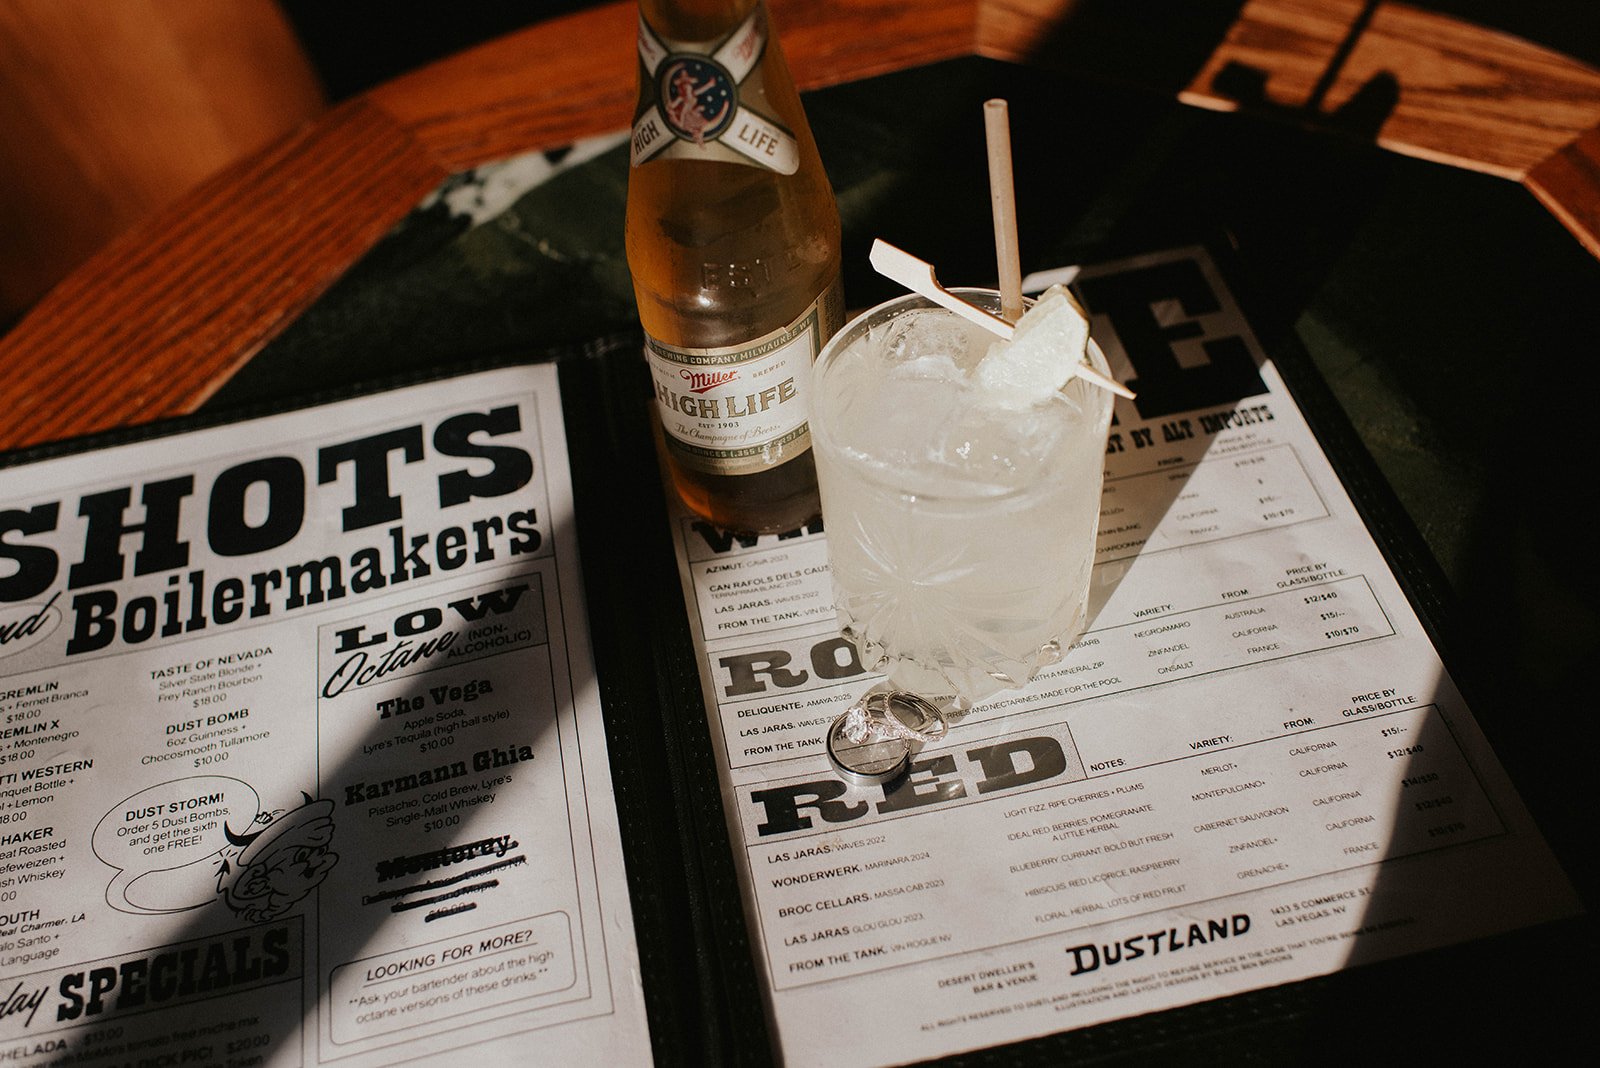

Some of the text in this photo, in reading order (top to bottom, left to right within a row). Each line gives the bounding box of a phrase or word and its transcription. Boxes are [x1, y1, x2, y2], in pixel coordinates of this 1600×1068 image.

[633, 120, 660, 156] HIGH
[737, 124, 779, 157] LIFE
[690, 329, 798, 366] COMPANY MILWAUKEE
[680, 368, 738, 394] Miller
[656, 376, 798, 419] HIGH LIFE
[689, 428, 738, 444] Champagne
[718, 421, 740, 429] 1903
[1130, 404, 1275, 450] BY ALT IMPORTS
[0, 405, 533, 604] SHOTS
[709, 570, 803, 593] CAN RAFOLS DELS
[1286, 562, 1329, 577] PRICE BY
[66, 509, 542, 656] Boilermakers
[335, 583, 530, 654] LOW
[714, 605, 736, 615] LAS
[718, 616, 771, 632] FROM THE
[1232, 623, 1278, 639] CALIFORNIA
[447, 629, 532, 660] ALCOHOLIC)
[1247, 626, 1359, 655] FRANCE $10/$70
[150, 646, 274, 681] TASTE OF NEVADA
[321, 631, 459, 699] Octane
[1057, 665, 1092, 677] MINERAL
[158, 673, 263, 704] Frey Ranch Bourbon
[159, 663, 255, 691] Silver State Blonde
[1040, 676, 1122, 700] MADE FOR THE POOL
[376, 679, 493, 721] The Vega
[806, 697, 833, 708] AMAYA
[1351, 687, 1397, 705] PRICE BY
[50, 719, 60, 730] X
[166, 708, 250, 736] DUST BOMB
[363, 709, 511, 755] Lyre's Tequila (high ball style)
[403, 715, 435, 731] Apple
[740, 718, 826, 738] LAS WAVES
[14, 729, 80, 749] Montenegro
[141, 730, 270, 766] Chocosmooth Tullamore
[166, 725, 239, 748] 6oz Guinness
[420, 736, 455, 754] $10.00
[1090, 717, 1316, 772] NOTES: VARIETY: FROM:
[744, 742, 794, 757] FROM THE
[22, 759, 93, 781] WESTERN
[345, 743, 535, 807] Karmann Ghia
[1048, 740, 1338, 809] RIPE CHERRIES PLUMS CALIFORNIA
[34, 778, 66, 793] Bottle
[368, 774, 513, 818] Pistachio, Cold Lyre's
[751, 736, 1068, 837] RED
[1032, 744, 1424, 836] RED CALIFORNIA $12/$40
[15, 795, 54, 809] Lemon
[125, 792, 225, 822] DUST STORM!
[386, 792, 497, 828] Single-Malt Whiskey
[117, 815, 189, 838] Order 5 Dust
[129, 820, 218, 847] and get the sixth
[423, 814, 460, 833] $10.00
[1061, 790, 1362, 862] CURRANT BOLD BUT FRESH CABERNET SAUVIGNON CALIFORNIA
[1086, 822, 1120, 835] HERBAL
[18, 839, 67, 859] Roasted
[143, 834, 203, 856] one FREE!
[767, 835, 887, 864] LAS WAVES 2022
[1068, 814, 1376, 887] RED RASPBERRY CALIFORNIA
[1343, 841, 1379, 856] FRANCE
[865, 857, 909, 871] MARINARA
[17, 868, 67, 886] Whiskey
[778, 883, 924, 918] BROC MASSA CAB
[1301, 890, 1356, 909] COMMERCE
[71, 913, 86, 924] LA
[1275, 905, 1347, 928] LAS NV
[17, 935, 51, 951] Santo
[784, 935, 808, 947] LAS
[1066, 914, 1251, 977] DUSTLAND
[365, 929, 534, 982] LOOKING FOR MORE?
[789, 953, 850, 973] FROM THE
[56, 927, 290, 1022] SPECIALS
[383, 949, 555, 1004] your bartender about the high
[938, 973, 977, 988] DESERT
[973, 974, 1039, 995] BAR VENUE
[356, 980, 499, 1025] octane versions of these
